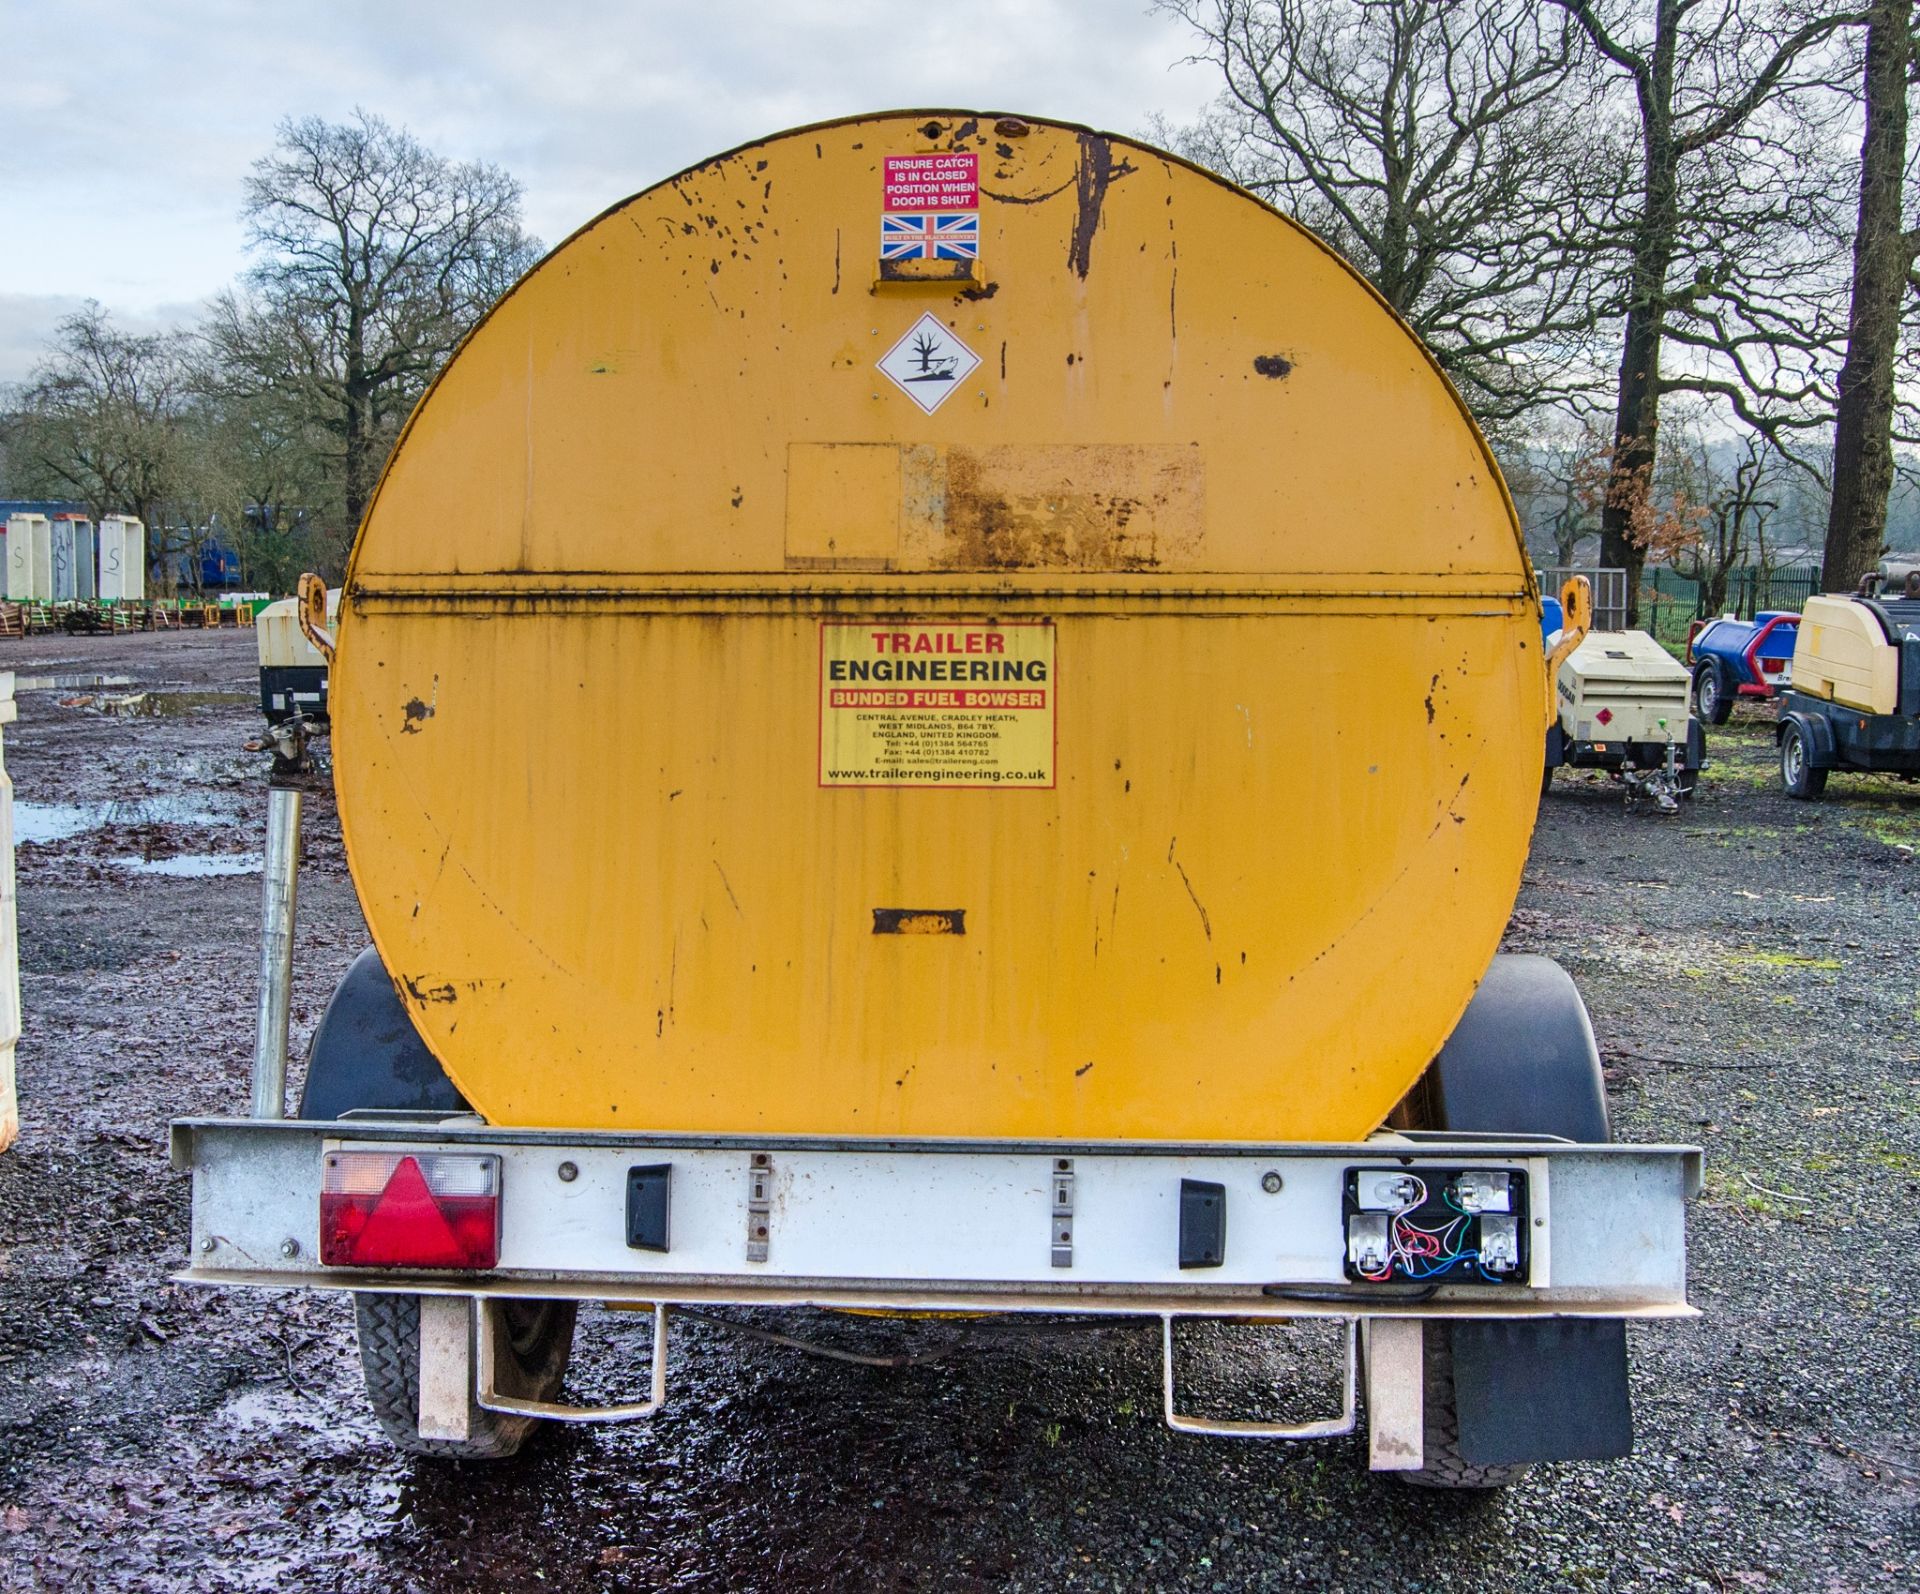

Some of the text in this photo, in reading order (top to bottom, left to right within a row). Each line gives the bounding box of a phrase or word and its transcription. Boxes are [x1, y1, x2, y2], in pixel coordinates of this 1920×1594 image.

[888, 158, 973, 170] ENSURE CATCH
[895, 171, 967, 182] IS IN CLOSED
[887, 183, 975, 194] POSITION WHEN
[892, 195, 971, 206] DOOR IS SHUT
[108, 547, 119, 571] S
[871, 633, 1004, 653] TRAILER
[830, 660, 1047, 681] ENGINEERING
[833, 692, 1042, 706] BUNDED FUEL BOWSER
[900, 714, 939, 722] AVENUE,
[986, 714, 1019, 722] HEATH,
[906, 723, 955, 731] MIDLANDS,
[872, 731, 917, 739] ENGLAND,
[922, 740, 954, 748] (0)1384
[923, 749, 955, 757] (0)1384
[907, 757, 999, 766] sales@trailereng.com
[828, 768, 1046, 781] www.trailerengineering.co.uk
